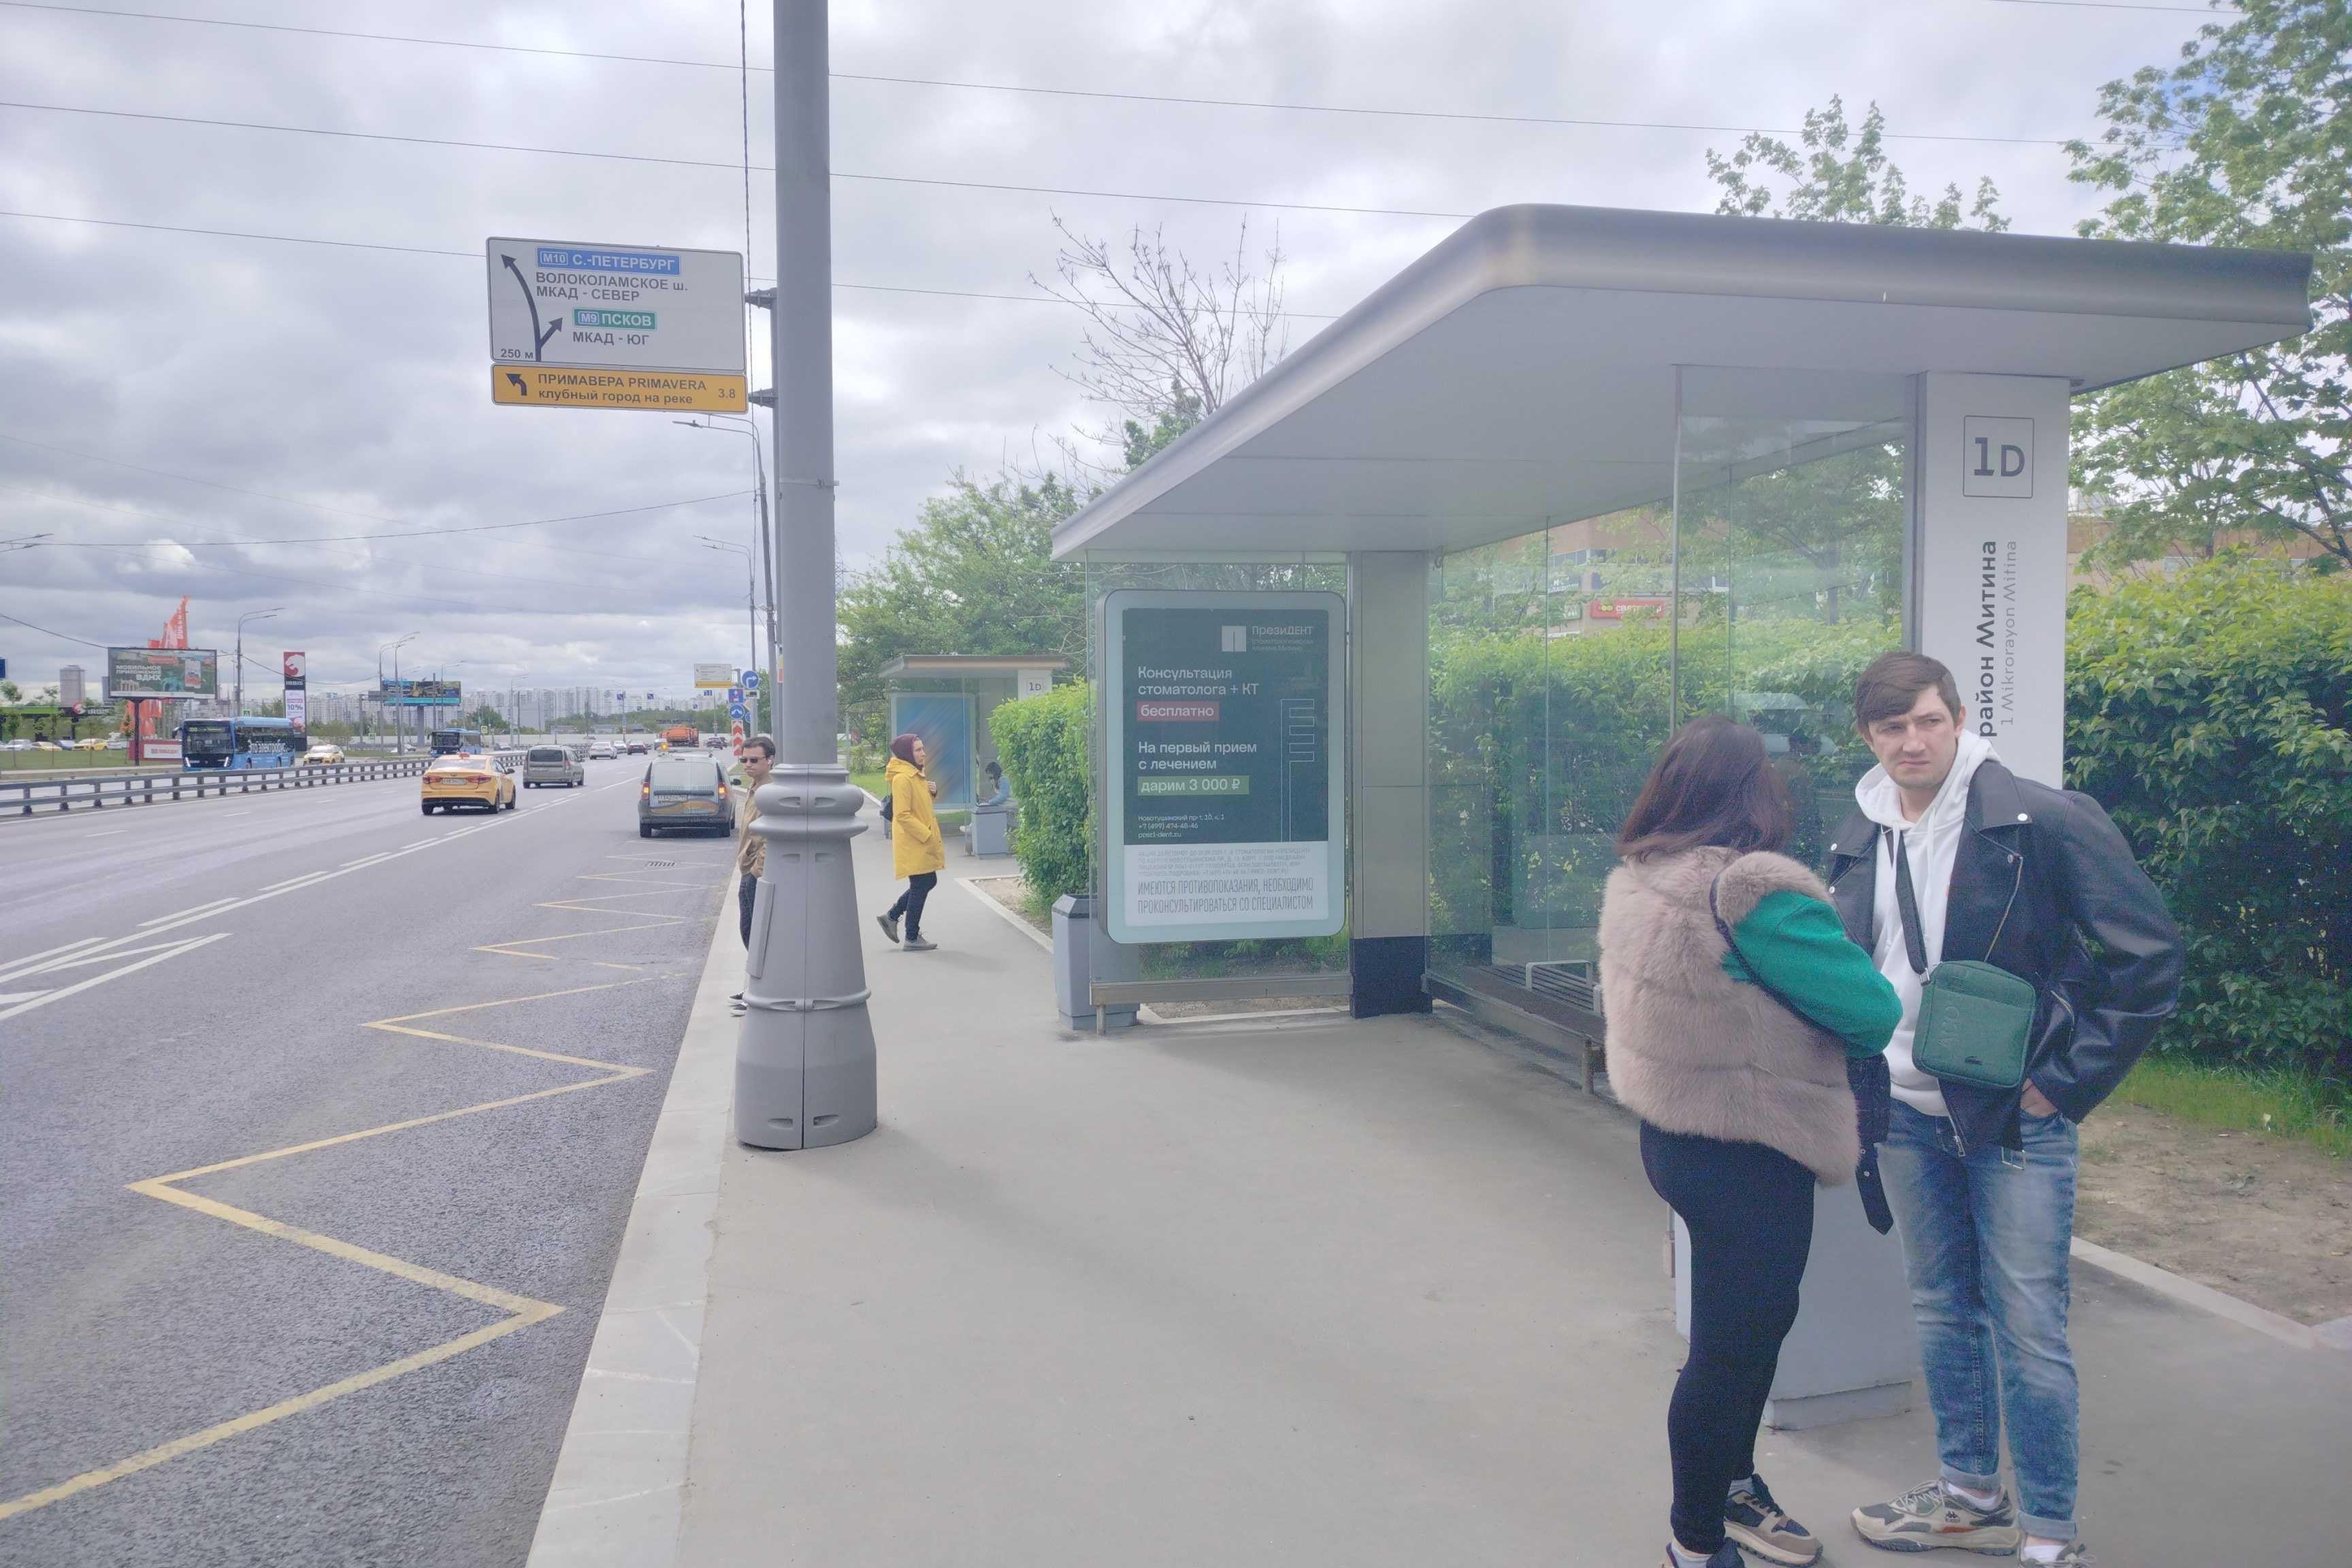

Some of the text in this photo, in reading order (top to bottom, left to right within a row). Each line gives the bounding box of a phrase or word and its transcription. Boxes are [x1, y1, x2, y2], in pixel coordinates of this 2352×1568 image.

[543, 253, 675, 270] М10 С.-ПЕТЕРБУРГ
[536, 272, 688, 291] ВОЛОКОЛАМСКОЕ ш.
[536, 286, 578, 300] МКАД
[591, 289, 640, 301] СЕВЕР
[581, 313, 652, 327] М9 ПСКОВ
[572, 331, 614, 346] МКАД
[627, 334, 650, 346] ЮГ
[500, 348, 521, 359] 250
[538, 374, 706, 391] ПРИМАВЕРА PRIMAVERA
[538, 389, 693, 405] клубный город на реке
[718, 388, 736, 399] 3.8
[1974, 436, 2025, 477] 1D
[1975, 541, 1998, 738] район Митина
[2001, 540, 2018, 725] 1 Mikrorayon Mitina
[1138, 666, 1233, 681] Консультация
[1138, 683, 1260, 696] стоматолога + КТ
[1141, 704, 1214, 717] бесплатно
[1138, 741, 1258, 755] На первый прием
[1138, 760, 1218, 770] с лечением
[1141, 781, 1186, 794] дарим
[1189, 779, 1198, 791] 3
[1202, 779, 1228, 791] 000
[1138, 877, 1313, 896] ИМЕЮТСЯ ПРОТИВОПОКАЗАНИЯ, НЕОБХОДИМО
[1138, 895, 1313, 914] ПРОКОНСУЛЬТИРОВАТЬСЯ СО СПЕЦИАЛИСТОМ
